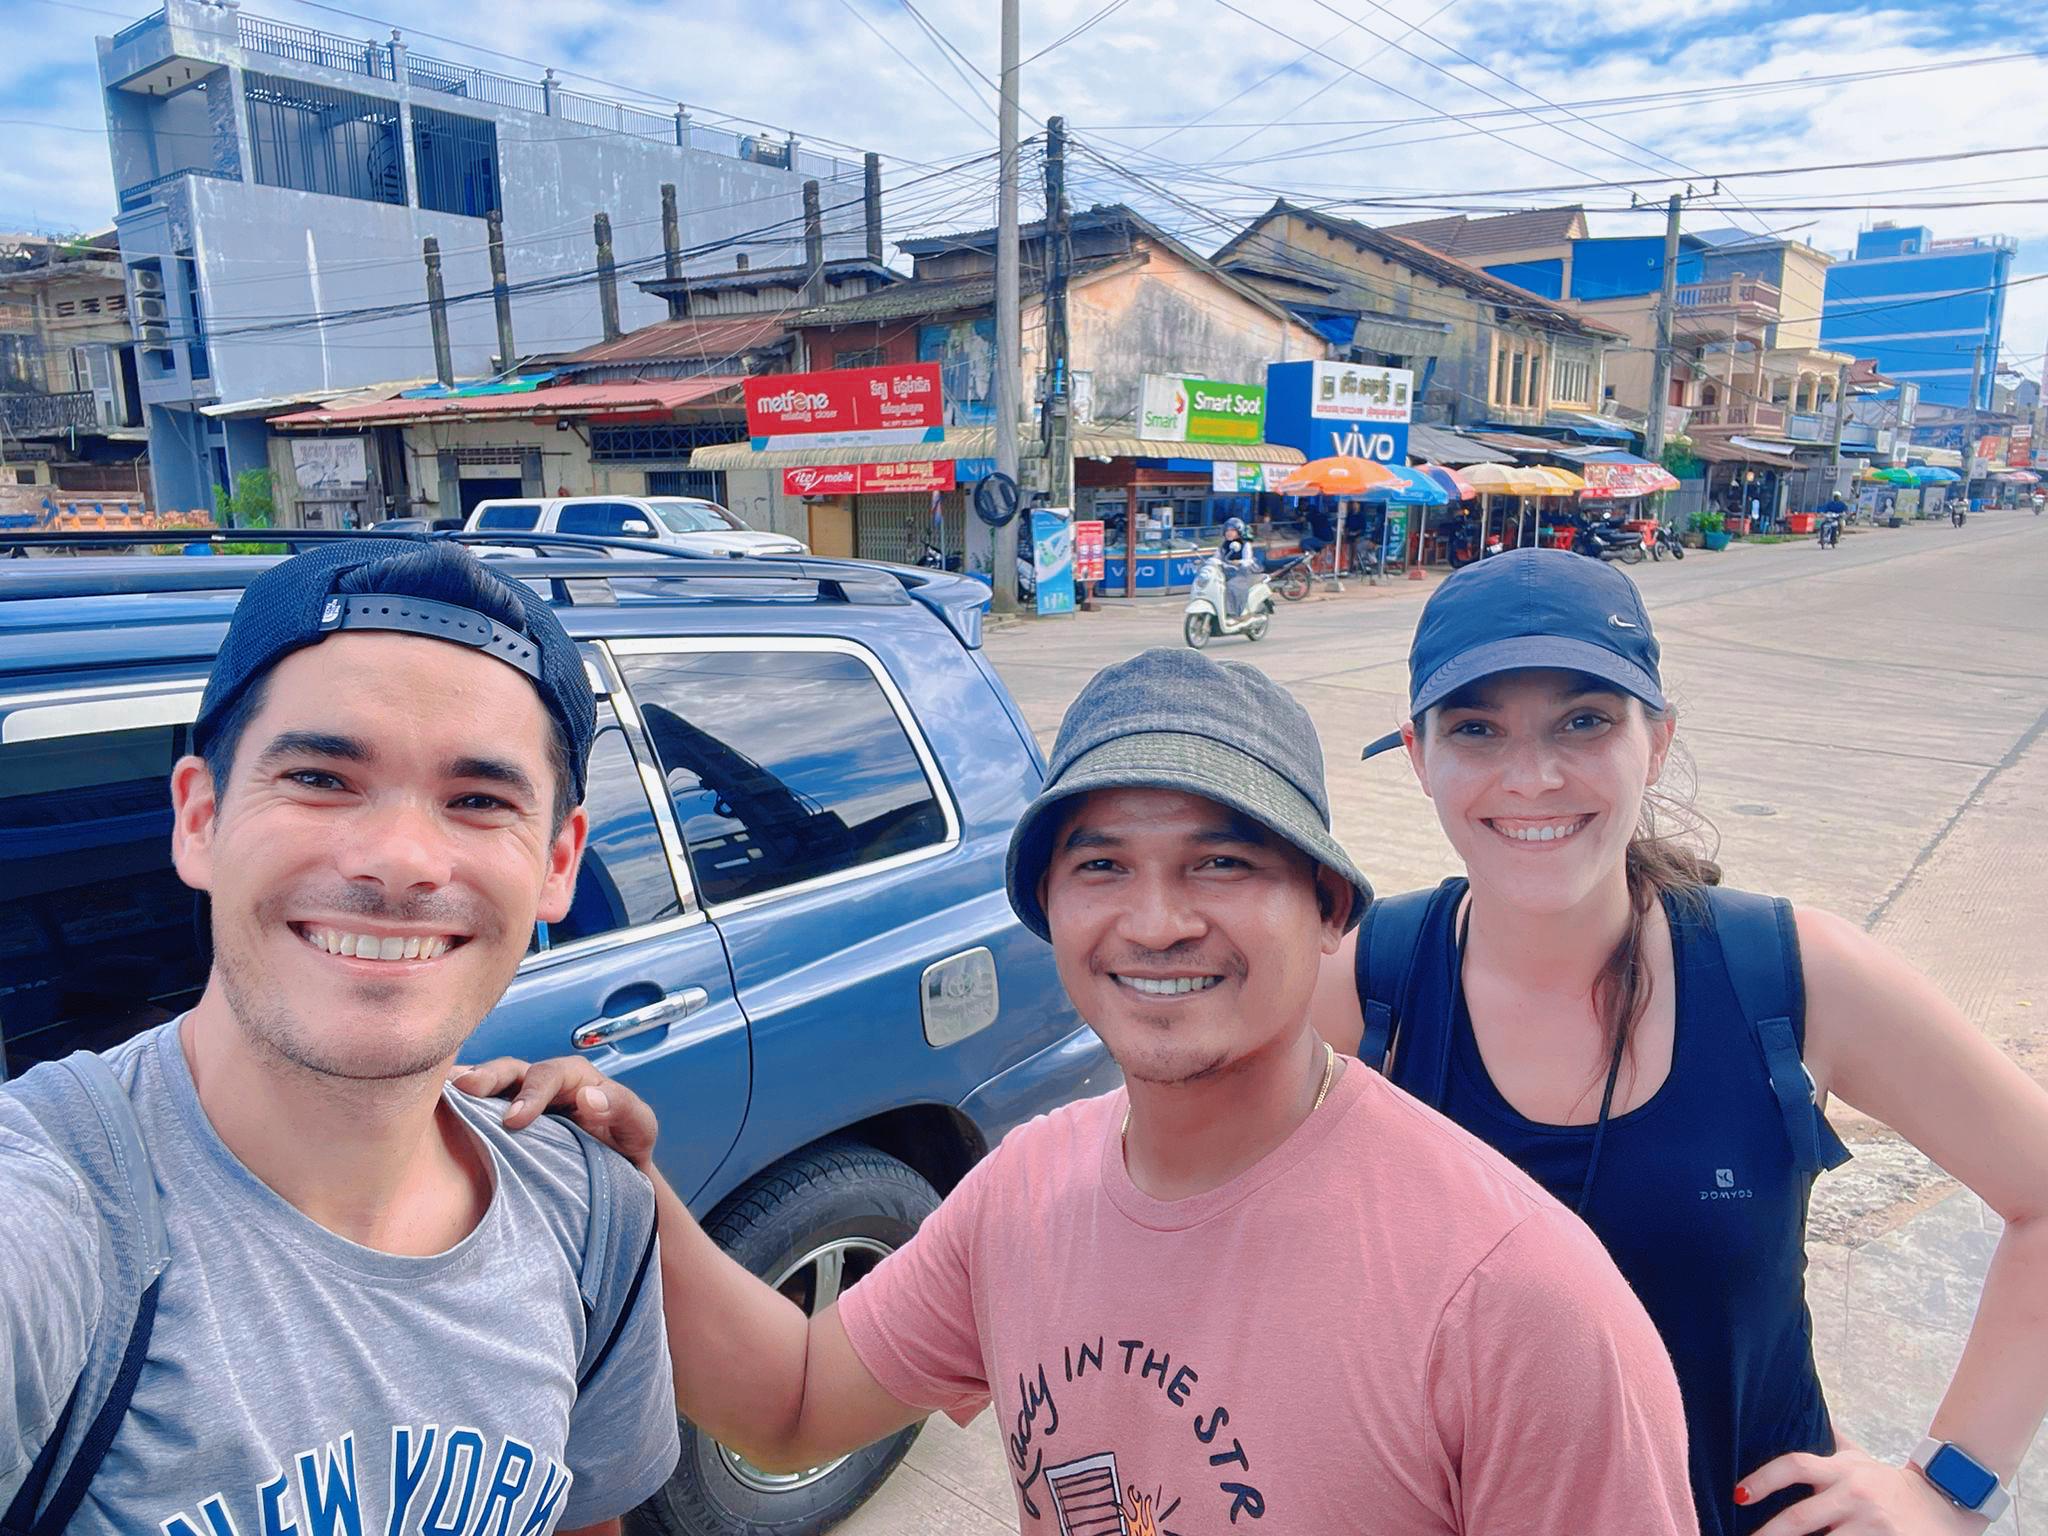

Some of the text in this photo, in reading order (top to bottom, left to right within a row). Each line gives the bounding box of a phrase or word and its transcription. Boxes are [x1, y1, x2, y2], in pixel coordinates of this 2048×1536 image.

[757, 389, 830, 414] metfone
[1193, 390, 1262, 416] Smart Spot
[1143, 410, 1179, 429] Smart
[1330, 423, 1395, 461] vivo
[824, 471, 854, 483] mobile
[1699, 1189, 1753, 1200] DOMYOS
[1064, 1336, 1104, 1382] IN
[1118, 1340, 1199, 1407] THE
